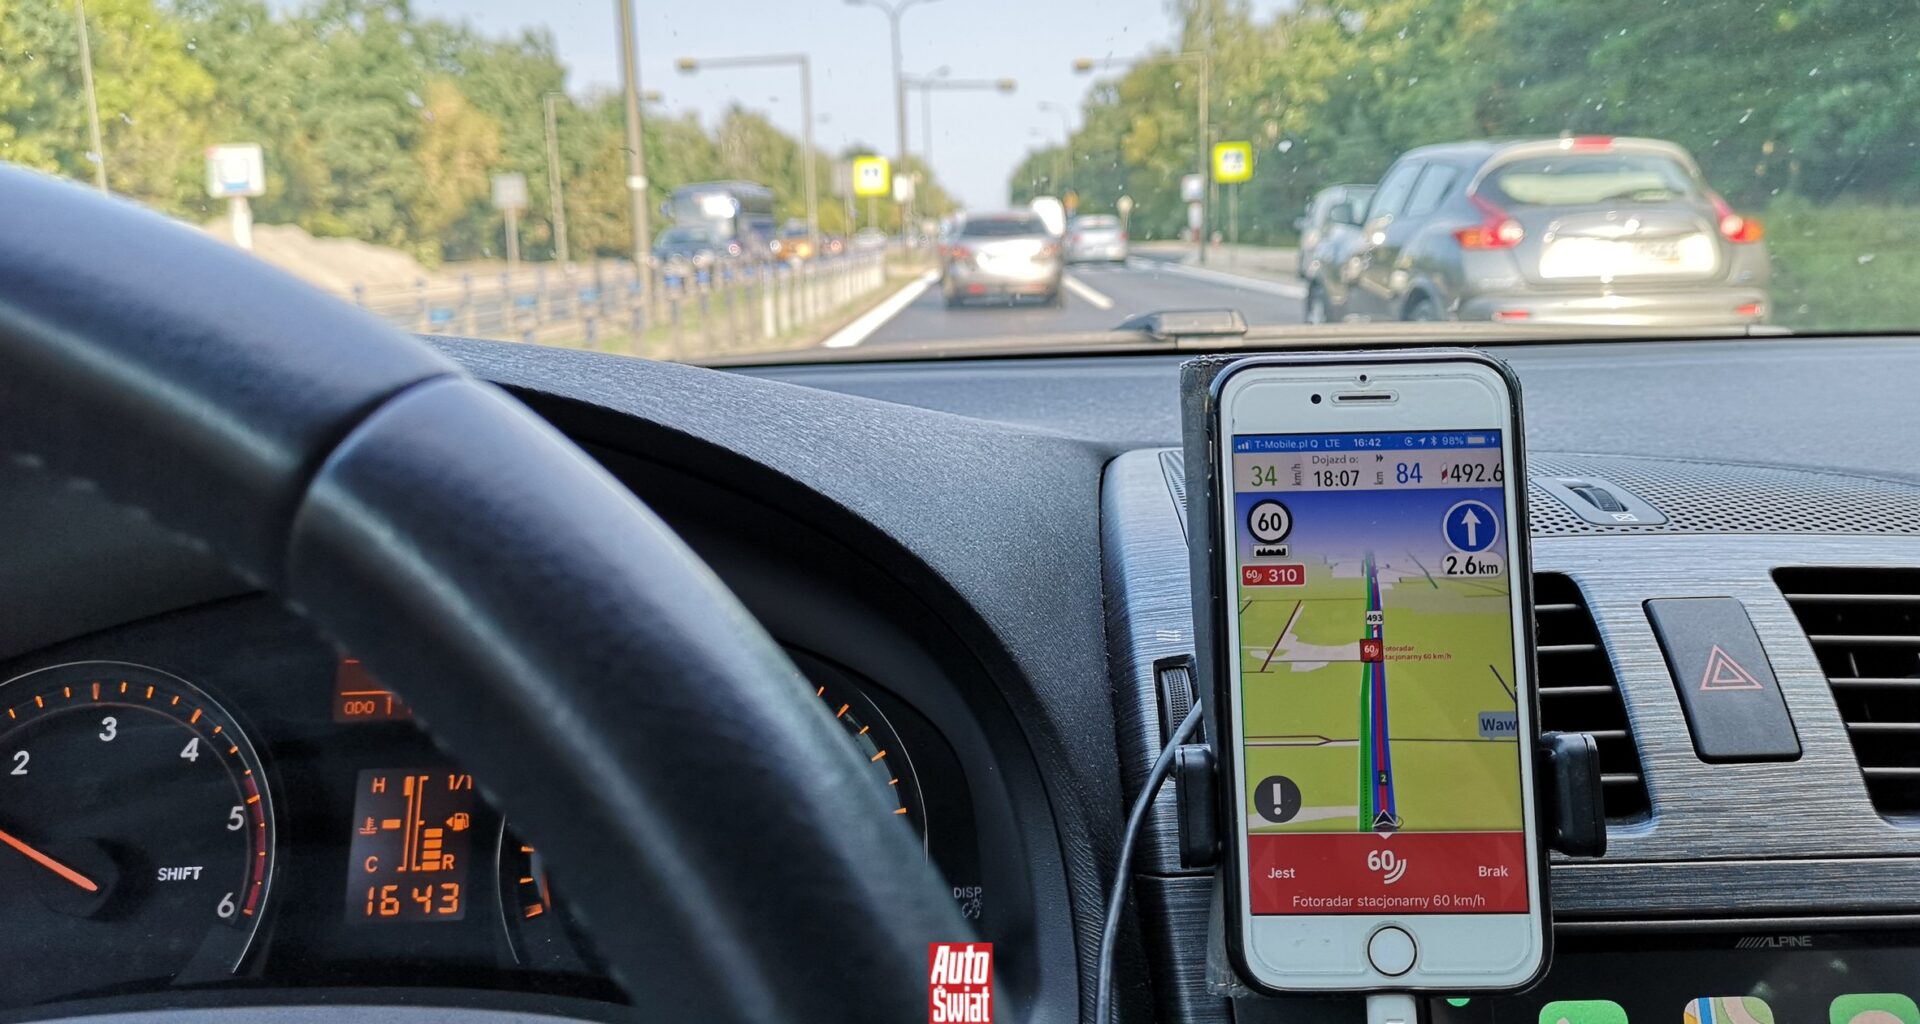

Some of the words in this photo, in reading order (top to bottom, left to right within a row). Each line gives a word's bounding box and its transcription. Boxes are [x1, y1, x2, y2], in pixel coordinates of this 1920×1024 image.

[1254, 440, 1308, 449] T-Mobile.pl
[1325, 439, 1340, 448] LTE
[1353, 438, 1382, 447] 16:42
[1442, 436, 1464, 446] 98%
[1312, 455, 1347, 466] Dojazd
[1349, 456, 1359, 464] o:
[1251, 465, 1277, 487] 34
[1291, 463, 1302, 486] km/h
[1314, 470, 1360, 487] 18:07
[1396, 462, 1423, 484] 84
[1450, 463, 1504, 483] 492.6
[1258, 512, 1282, 532] 60
[1246, 570, 1258, 579] 60
[1268, 568, 1298, 582] 310
[1366, 614, 1383, 622] 493
[1364, 645, 1375, 653] 60
[99, 716, 118, 741] 3
[180, 737, 200, 762] 4
[10, 750, 30, 775] 2
[371, 777, 386, 793] H
[449, 774, 472, 790] 1/1
[226, 805, 245, 830] 5
[364, 856, 378, 873] C
[442, 854, 455, 870] R
[1367, 849, 1395, 871] 60
[157, 866, 203, 881] SHIFT
[1267, 867, 1296, 879] Jest
[1478, 865, 1509, 877] Brak
[217, 892, 235, 918] 6
[1292, 896, 1353, 907] Fotoradar
[1357, 894, 1429, 909] stacjonarny
[1433, 894, 1450, 906] 60
[1453, 893, 1486, 908] km/h
[1760, 935, 1813, 948] ALPINE
